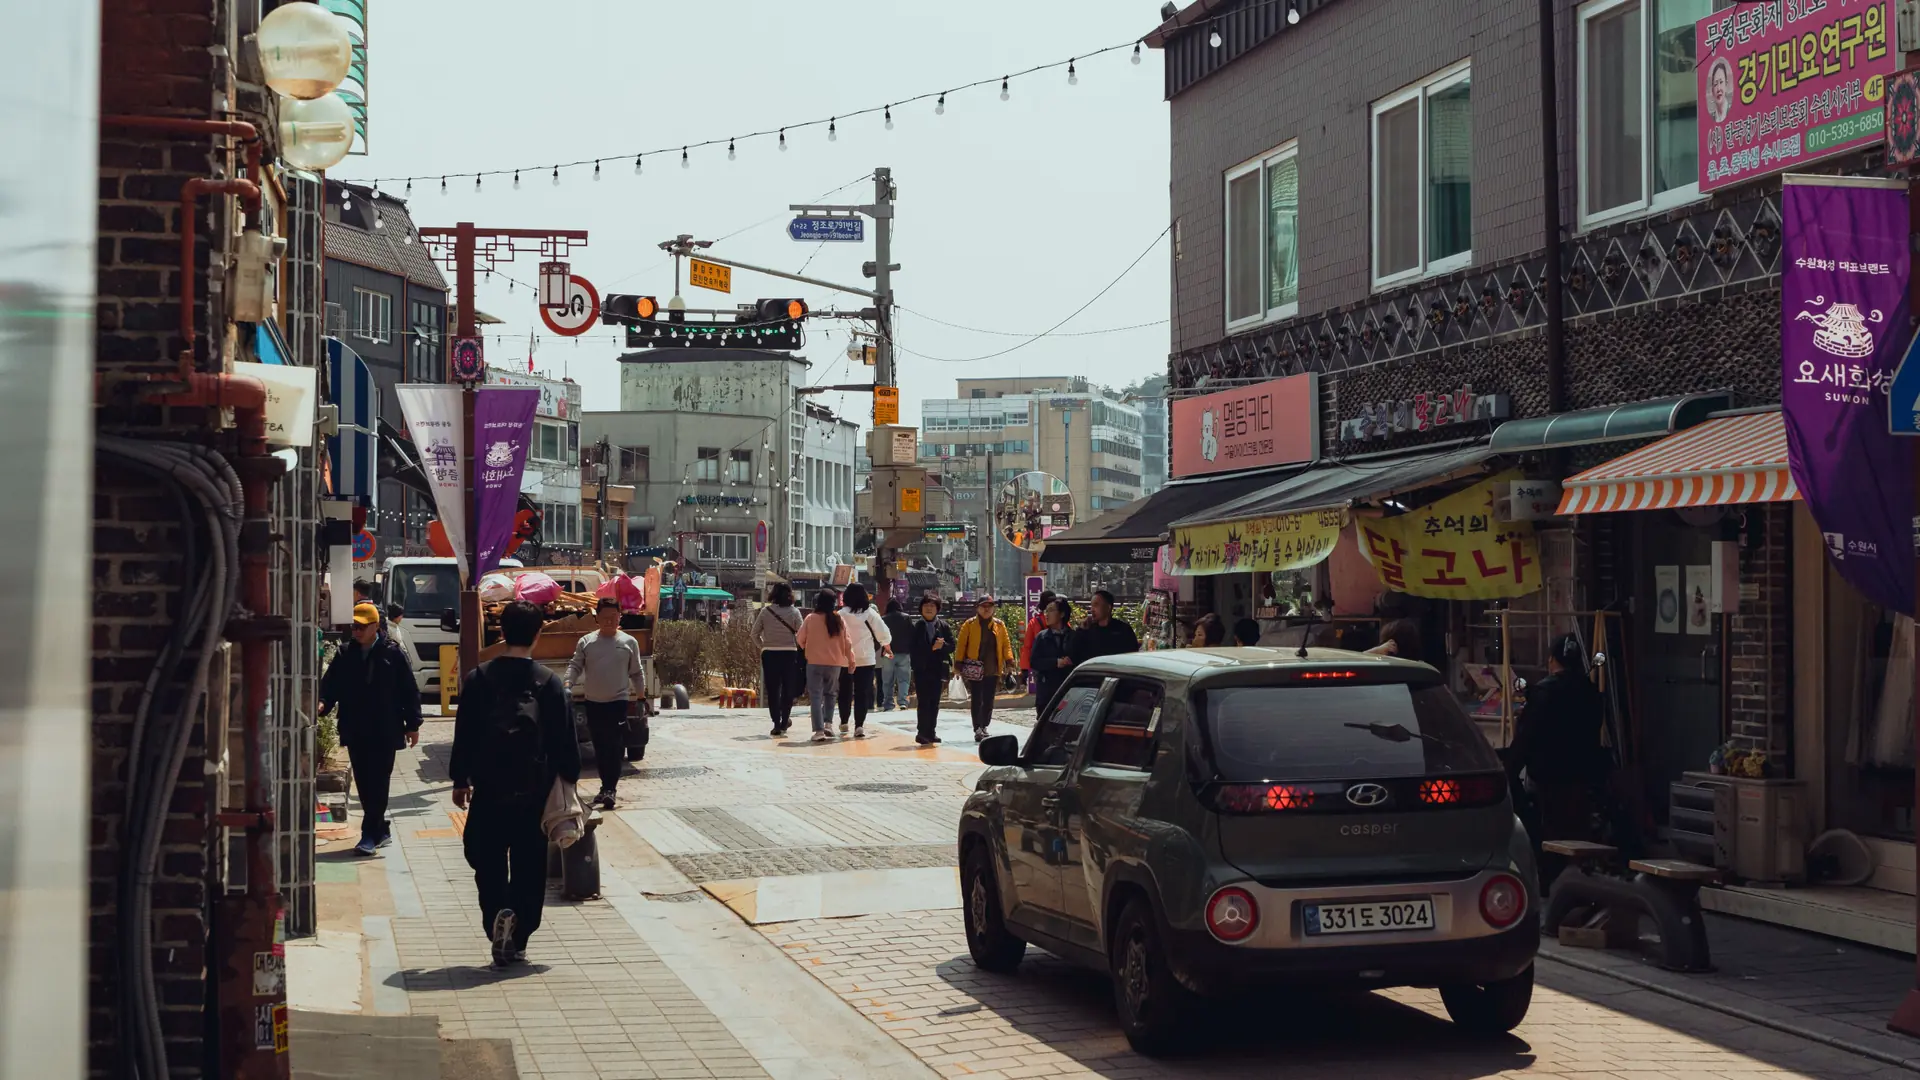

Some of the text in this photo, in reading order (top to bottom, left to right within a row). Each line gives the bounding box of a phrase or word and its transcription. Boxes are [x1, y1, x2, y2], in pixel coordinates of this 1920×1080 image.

[1705, 1, 1783, 56] 무형문화재
[1738, 1, 1887, 104] 경기민요연구원
[1868, 77, 1883, 98] 4F
[1810, 78, 1863, 124] 수원시지부
[1808, 112, 1884, 149] 010-5393-6850
[1795, 257, 1891, 275] 수원화성 대표브랜드
[1825, 392, 1869, 405] SUWON
[1424, 514, 1488, 537] 추억의
[1363, 526, 1532, 589] 달고나
[1847, 540, 1877, 553] 수원시
[1340, 823, 1399, 836] casper
[1322, 903, 1429, 930] 331도 3024
